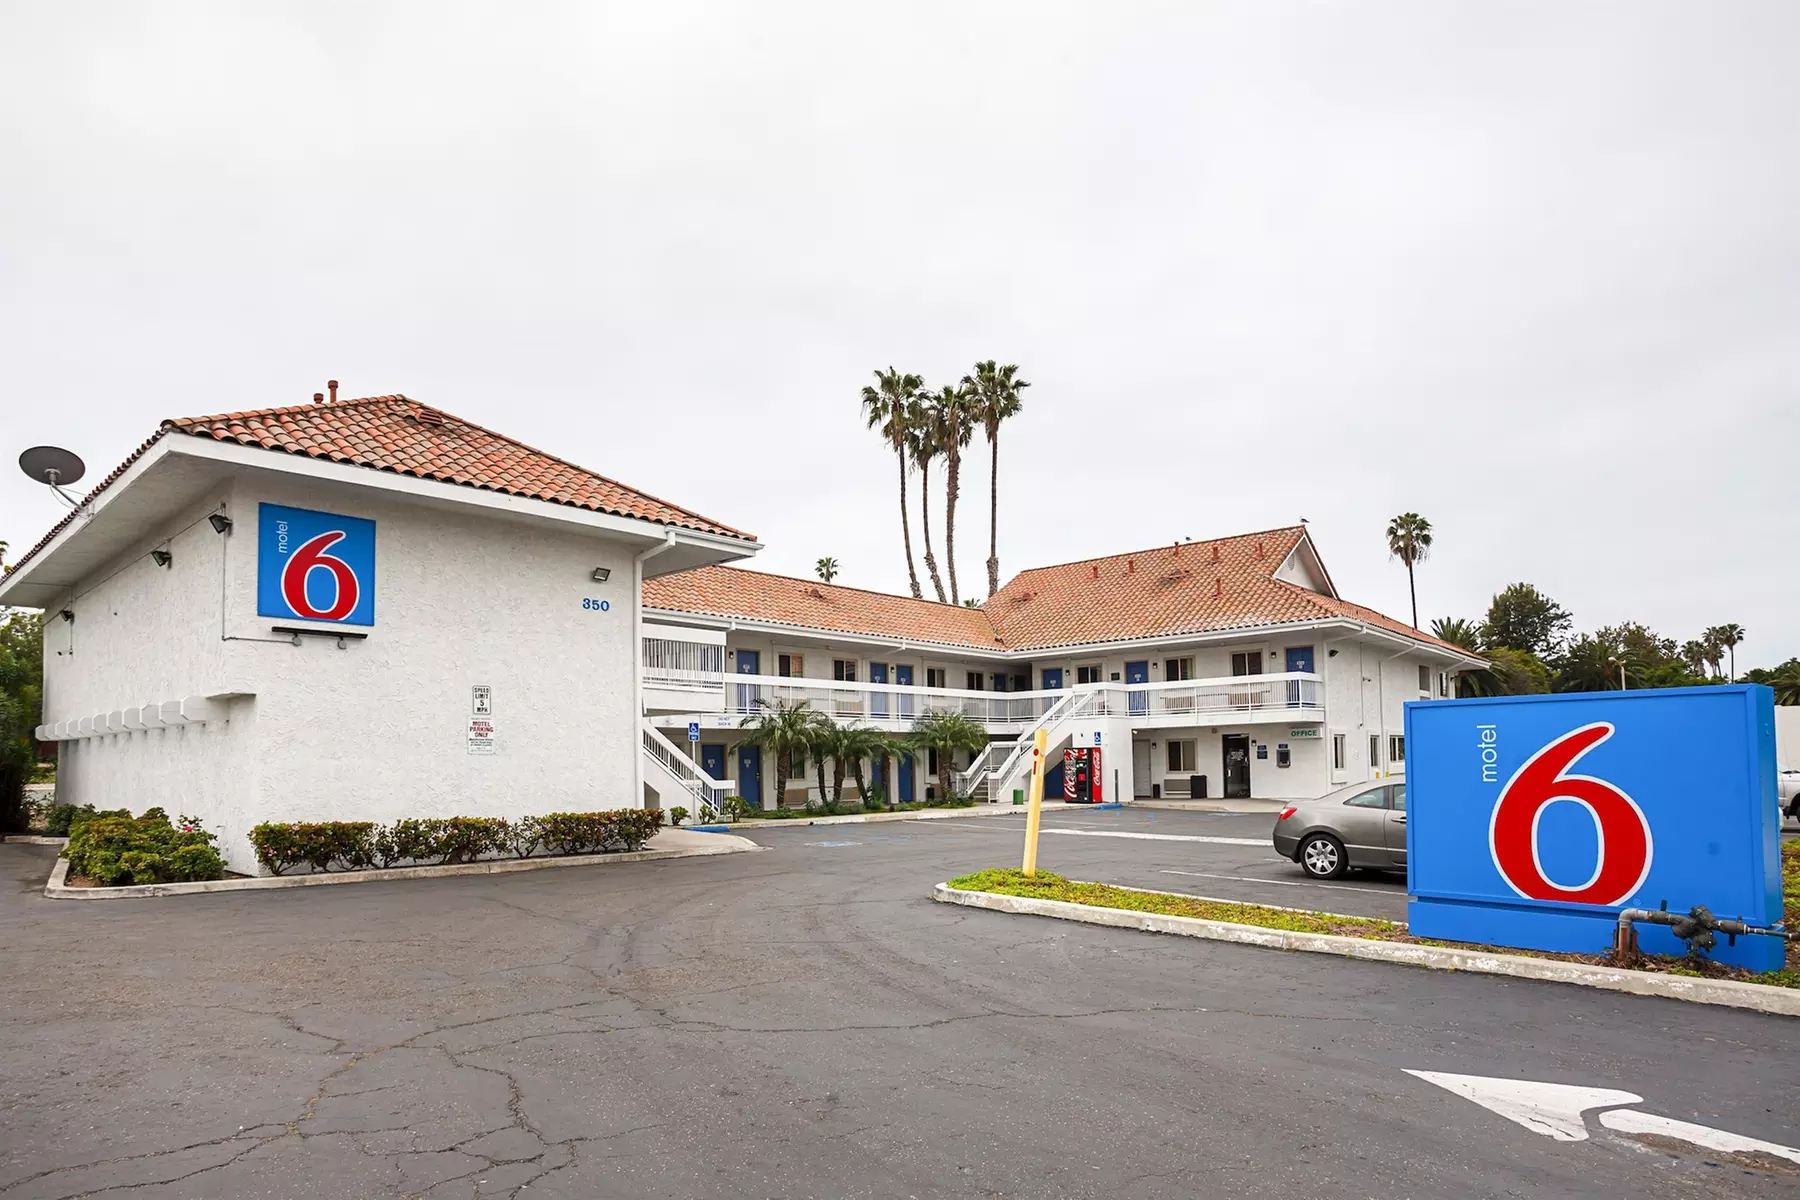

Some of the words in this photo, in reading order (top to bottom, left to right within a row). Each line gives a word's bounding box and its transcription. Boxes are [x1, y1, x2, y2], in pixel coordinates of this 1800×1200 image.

[276, 520, 288, 554] motel
[281, 530, 360, 621] 6
[582, 598, 610, 612] 350
[1290, 729, 1317, 737] OFFICE
[1476, 724, 1498, 782] motel
[1488, 721, 1654, 906] 6
